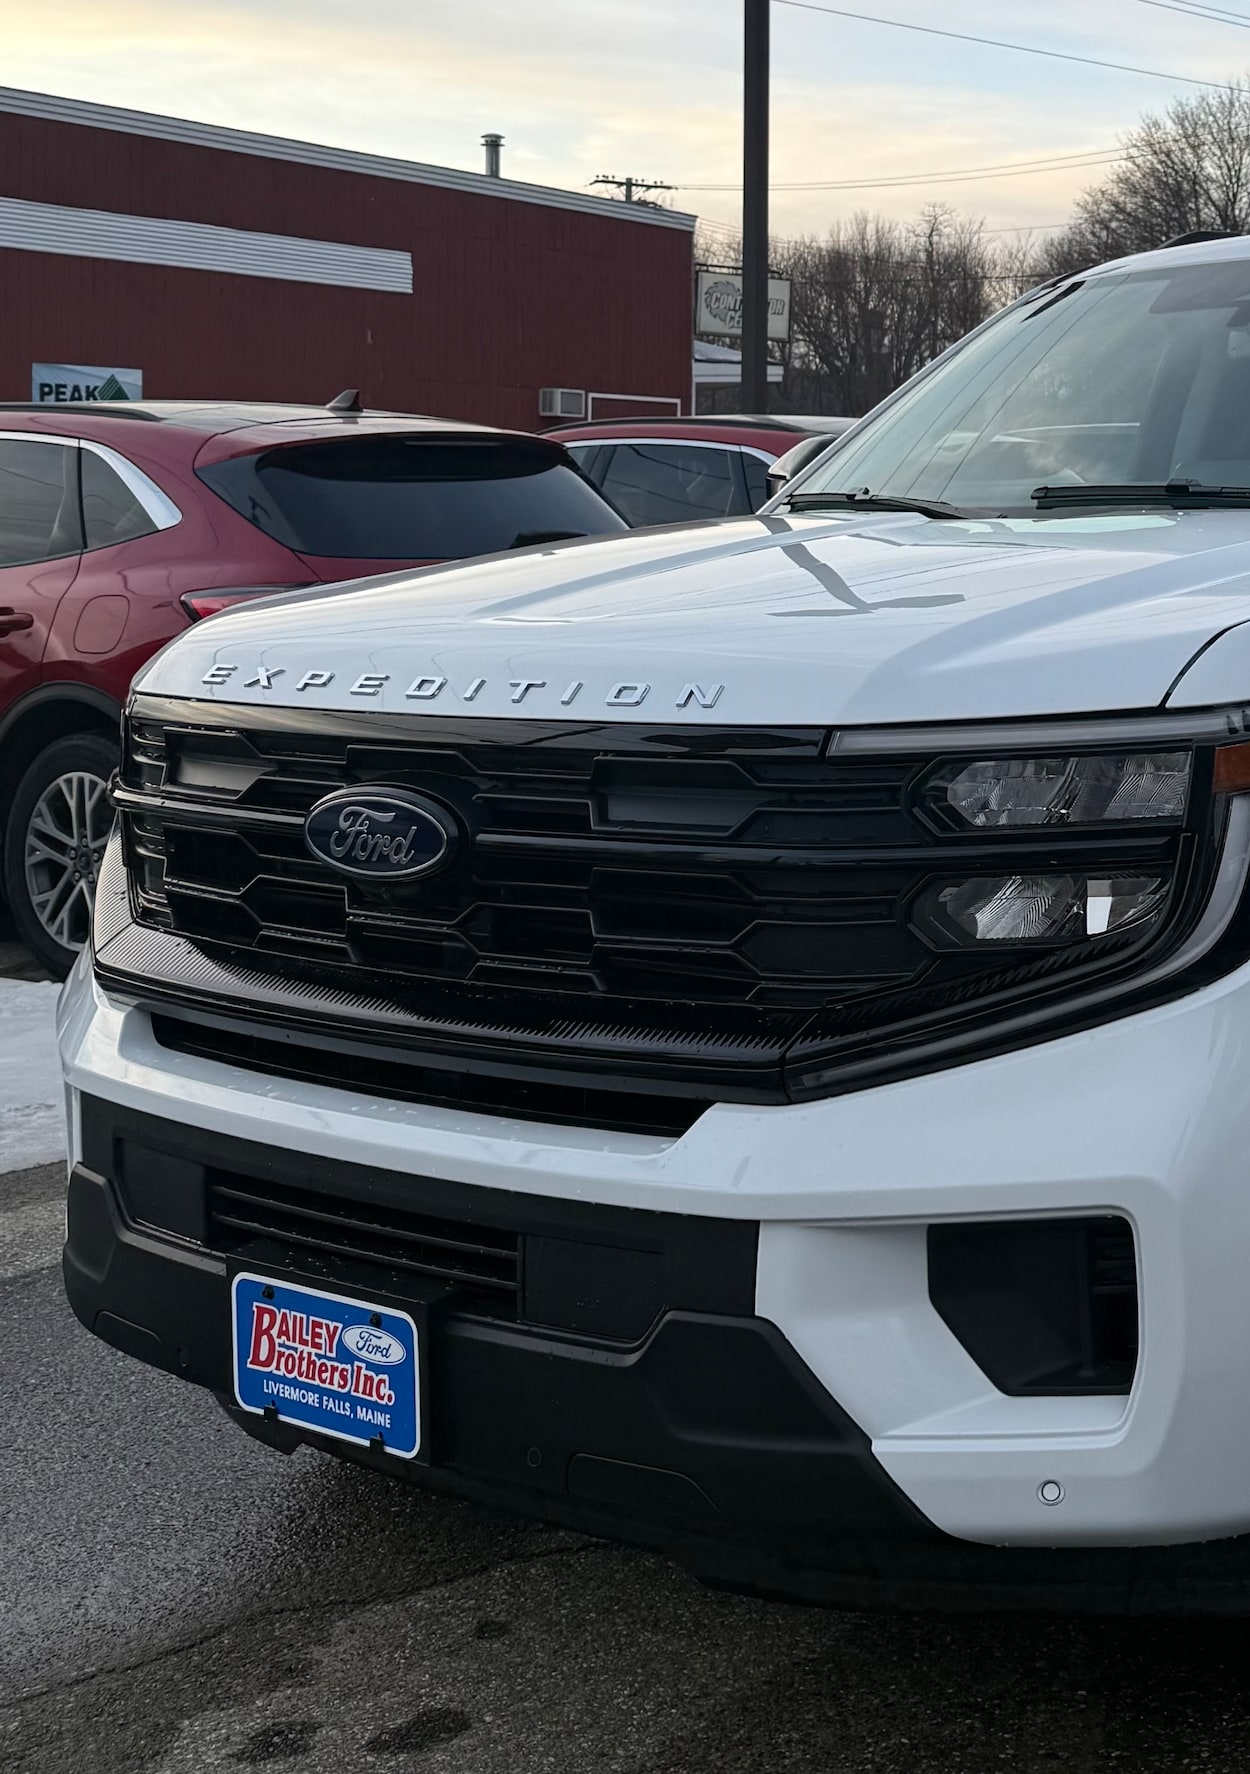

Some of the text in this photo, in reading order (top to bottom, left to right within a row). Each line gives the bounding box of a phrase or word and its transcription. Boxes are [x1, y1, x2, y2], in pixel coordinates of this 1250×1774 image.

[39, 382, 101, 402] PEAK
[201, 663, 725, 708] EXPEDITION
[329, 806, 418, 865] Ford
[248, 1303, 343, 1368] BAILEY
[356, 1330, 393, 1359] Ford
[263, 1379, 391, 1429] LIVERMORE FALLS, MAINE
[351, 1361, 396, 1406] Inc.
